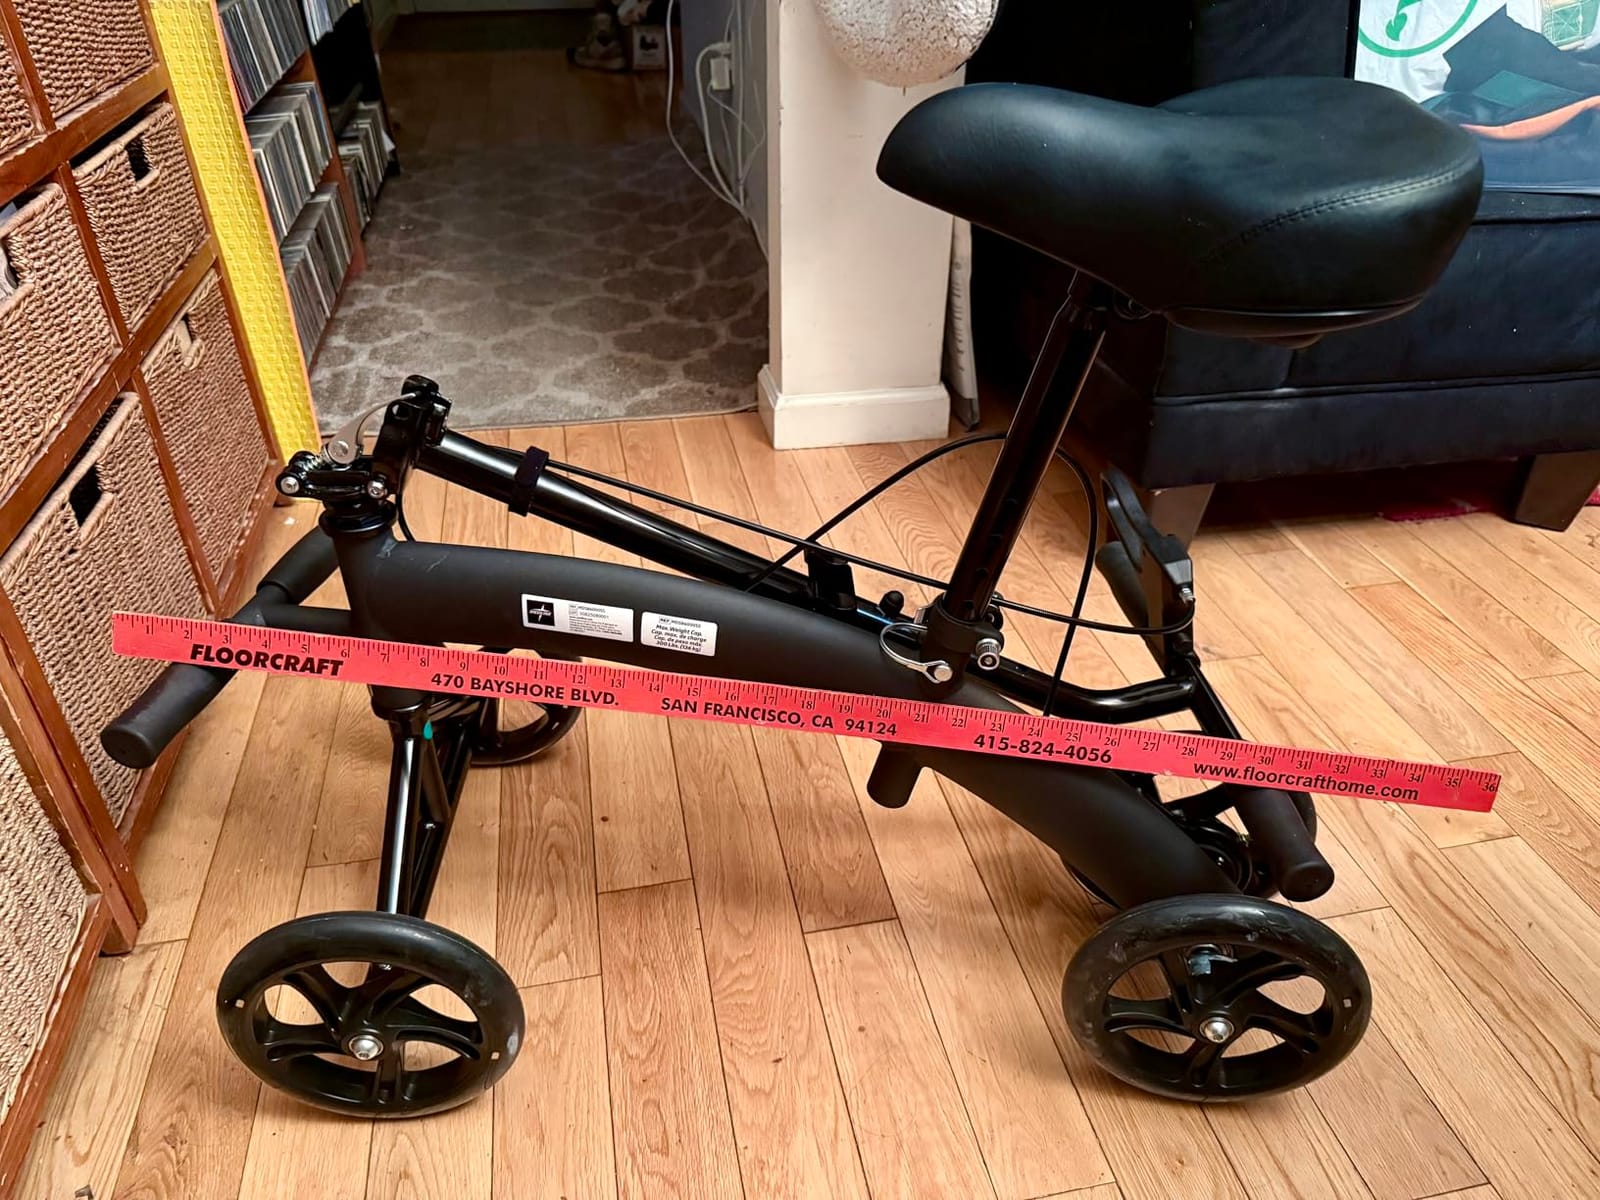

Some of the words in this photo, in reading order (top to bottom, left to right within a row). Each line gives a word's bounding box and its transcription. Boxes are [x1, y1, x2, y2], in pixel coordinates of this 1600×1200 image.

[190, 643, 344, 676] FLOORCRAFT
[431, 673, 464, 689] 470
[470, 677, 564, 699] BAYSHORE
[571, 689, 619, 706] BLVD.
[183, 630, 190, 639] 2
[222, 634, 229, 644] 3
[261, 639, 268, 648] 4
[301, 644, 308, 653] 5
[341, 648, 348, 658] 6
[380, 653, 387, 662] 7
[419, 657, 426, 667] 8
[459, 661, 466, 671] 9
[494, 665, 506, 676] 10
[533, 670, 544, 680] 11
[571, 674, 584, 684] 12
[611, 679, 622, 688] 13
[648, 683, 660, 693] 14
[687, 687, 698, 697] 15
[725, 691, 737, 701] 16
[763, 696, 774, 705] 17
[801, 700, 813, 710] 18
[838, 704, 850, 714] 19
[876, 708, 889, 718] 20
[914, 713, 926, 722] 21
[951, 718, 964, 728] 22
[990, 722, 1002, 732] 23
[1028, 727, 1040, 737] 24
[1065, 732, 1079, 742] 25
[1104, 737, 1117, 747] 26
[1142, 741, 1156, 751] 27
[1181, 746, 1195, 756] 28
[1220, 751, 1233, 761] 29
[1259, 755, 1272, 765] 30
[1295, 760, 1308, 770] 31
[1333, 764, 1347, 774] 32
[1371, 768, 1384, 779] 33
[1408, 773, 1421, 783] 34
[1446, 777, 1459, 788] 35
[1482, 782, 1496, 792] 36
[661, 697, 697, 714] SAN
[703, 702, 806, 728] FRANCISCO,
[812, 715, 834, 729] CA
[845, 719, 898, 736] 94124
[973, 734, 1113, 764] 415-824-4056
[1193, 762, 1420, 801] www.floorcrafthome.com
